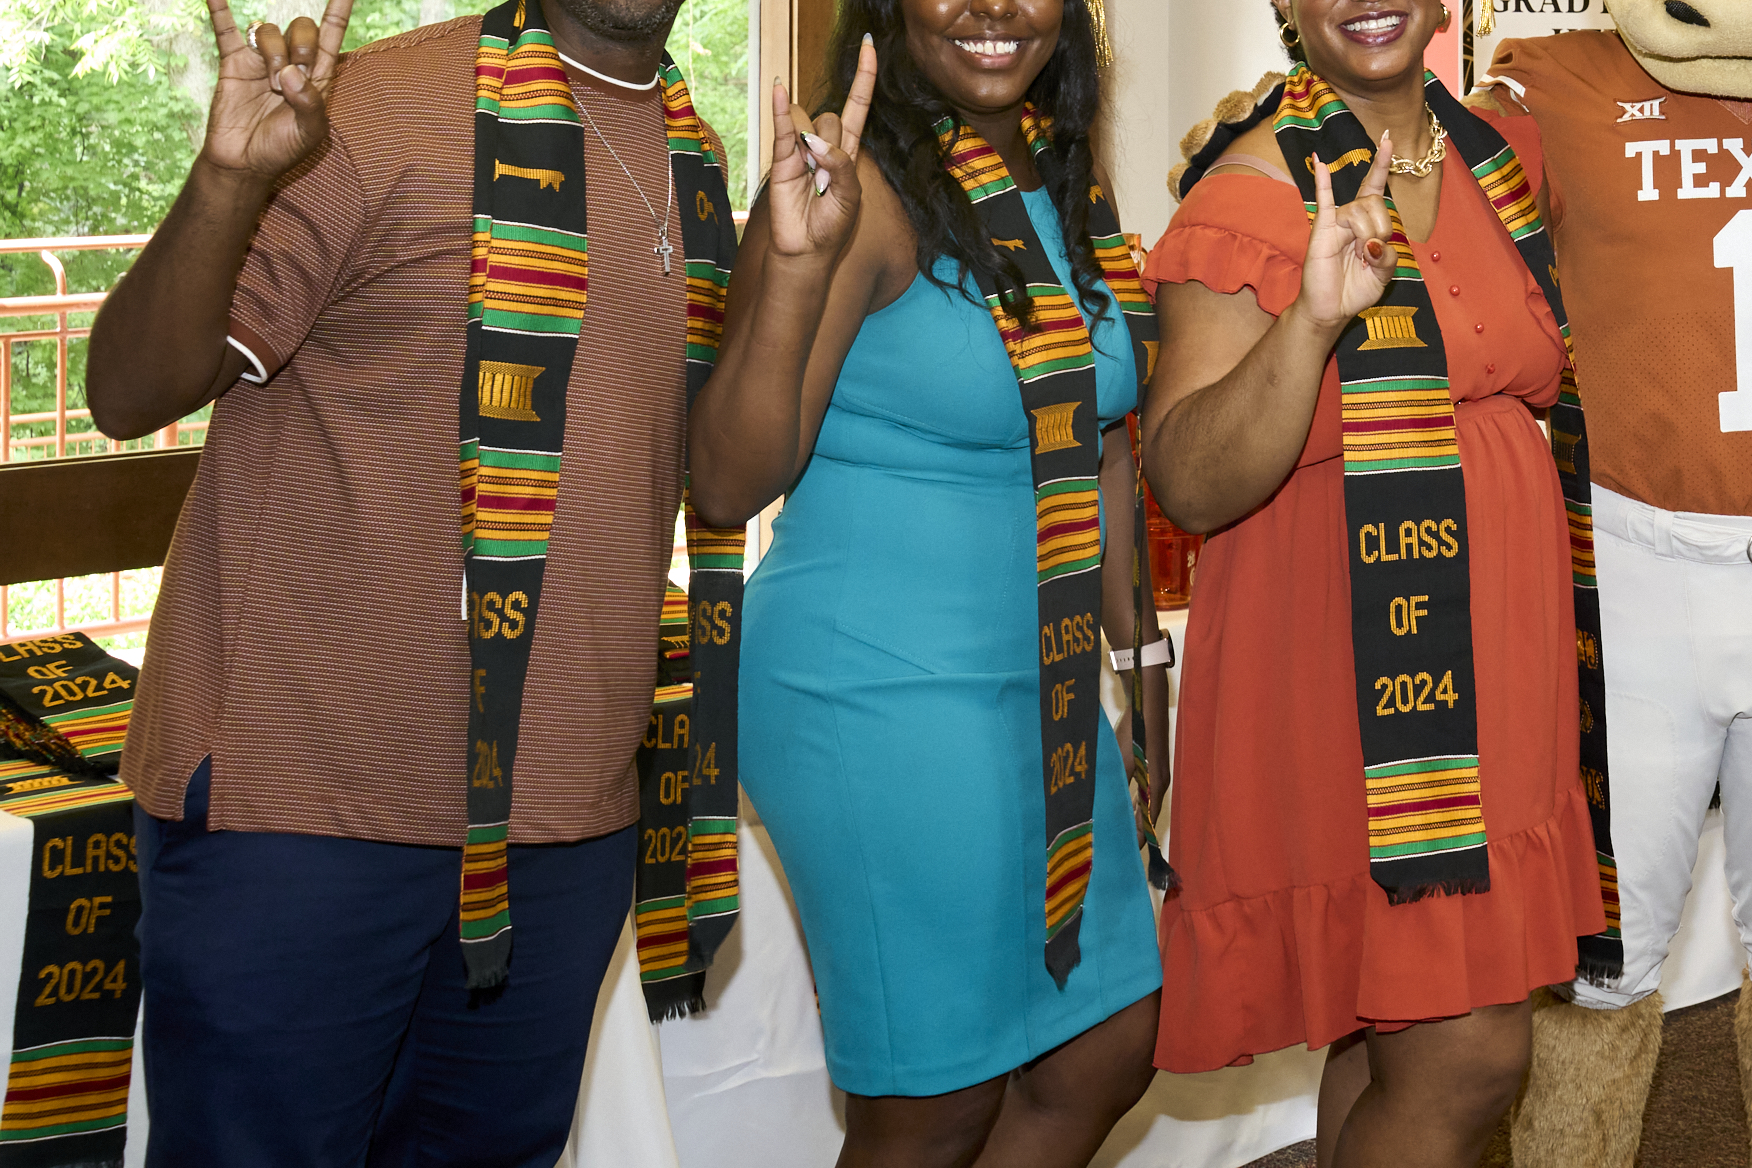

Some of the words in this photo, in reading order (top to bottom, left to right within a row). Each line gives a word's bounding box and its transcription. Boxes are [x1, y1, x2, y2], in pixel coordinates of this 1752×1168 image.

[1616, 96, 1667, 123] XII
[1359, 518, 1459, 564] CLASS
[1388, 594, 1430, 636] OF
[1041, 611, 1095, 666] CLASS
[26, 660, 74, 679] OF
[31, 671, 132, 708] 2024
[1052, 678, 1076, 721] OF
[1374, 669, 1459, 716] 2024
[659, 770, 690, 806] OF
[1050, 740, 1089, 796] 2024
[644, 825, 688, 865] 202
[65, 895, 113, 936] OF
[34, 958, 128, 1008] 2024
